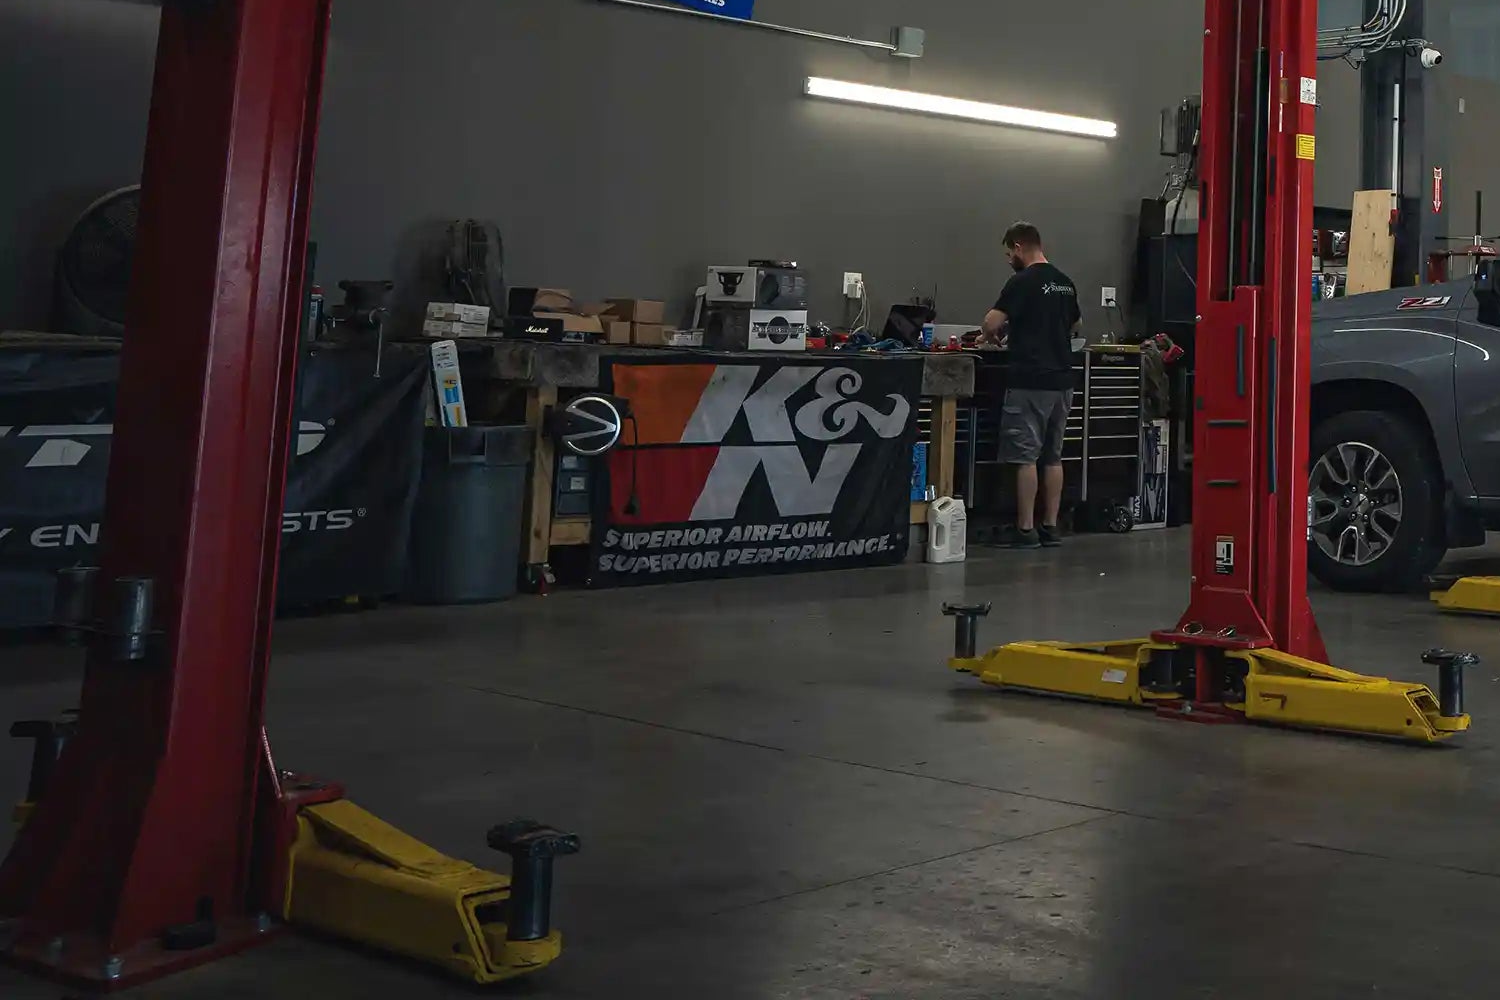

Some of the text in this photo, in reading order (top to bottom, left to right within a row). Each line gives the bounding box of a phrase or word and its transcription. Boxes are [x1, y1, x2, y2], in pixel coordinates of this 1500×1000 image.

[602, 521, 832, 551] SUPERIOR AIRFLOW.
[599, 534, 895, 574] SUPERIOR PERFORMANCE.
